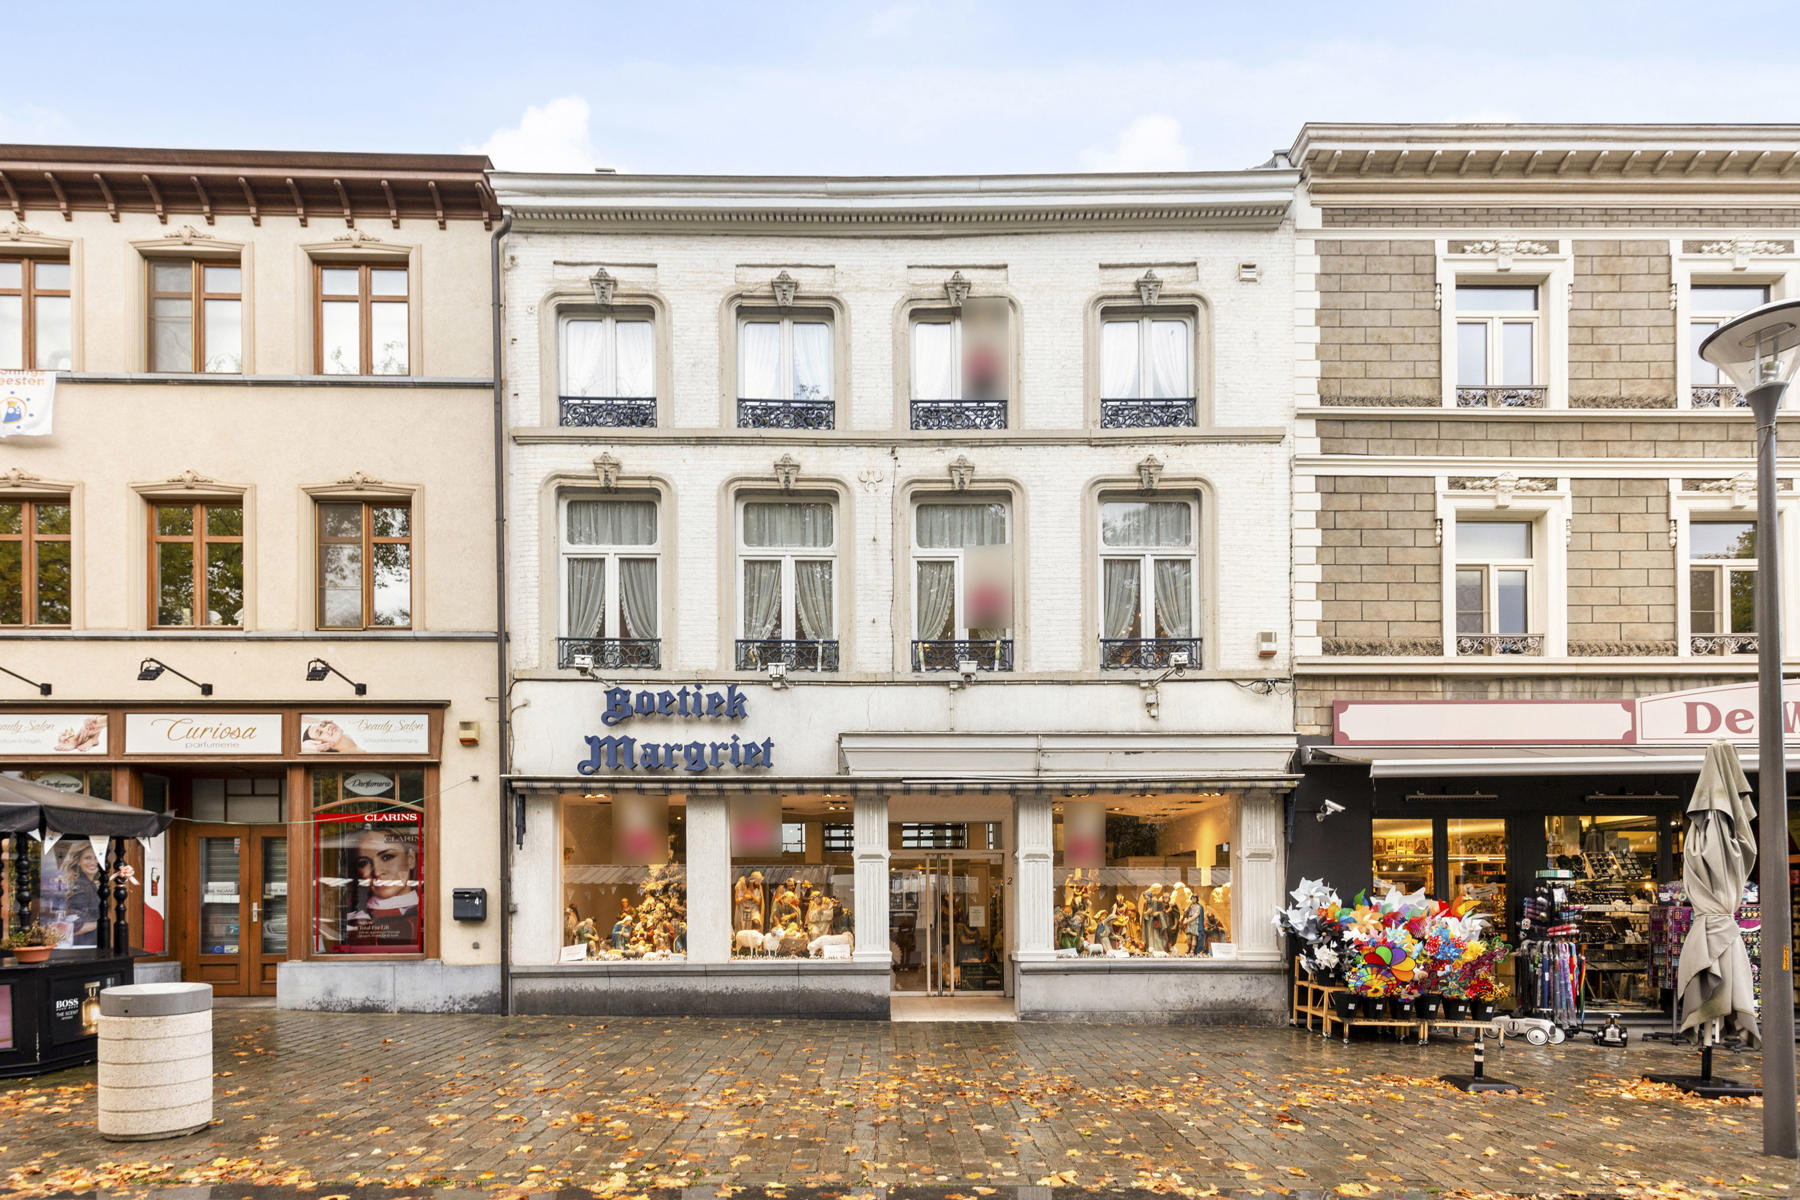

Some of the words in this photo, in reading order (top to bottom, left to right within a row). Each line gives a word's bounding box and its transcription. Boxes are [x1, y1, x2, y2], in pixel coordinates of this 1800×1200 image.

[601, 683, 748, 727] Boetiek
[356, 719, 393, 733] Beauty
[398, 719, 424, 732] Salon
[1683, 701, 1755, 735] De
[150, 717, 257, 742] Curiosa
[577, 734, 775, 776] Margriet
[364, 813, 418, 822] CLARINS
[1007, 877, 1012, 885] 2
[56, 998, 78, 1009] BOSS
